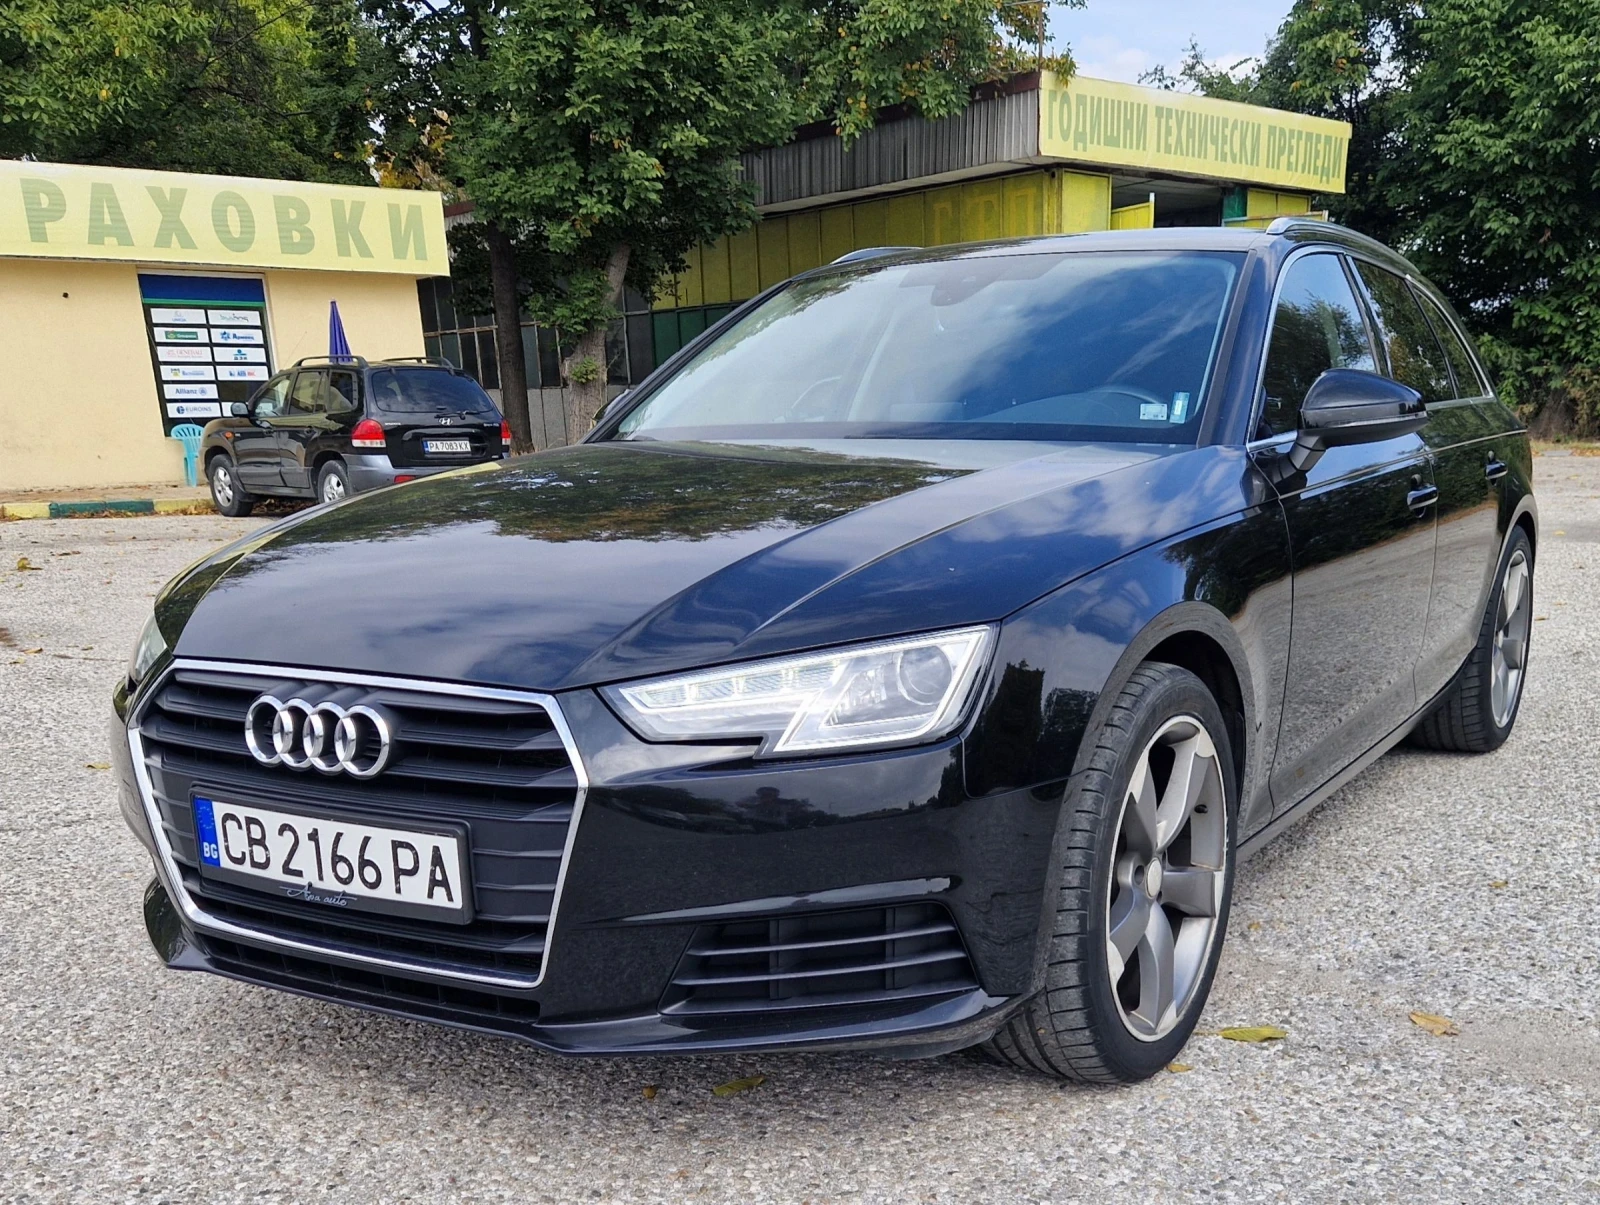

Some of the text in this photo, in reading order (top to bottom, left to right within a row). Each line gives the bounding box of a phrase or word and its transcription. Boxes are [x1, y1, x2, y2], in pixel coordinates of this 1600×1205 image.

[1048, 90, 1344, 185] ГОДИШНИ ТЕХНИЧЕСКИ ПРЕГЛЕДИ
[19, 178, 428, 261] РАХОВКИ
[203, 841, 219, 859] BG
